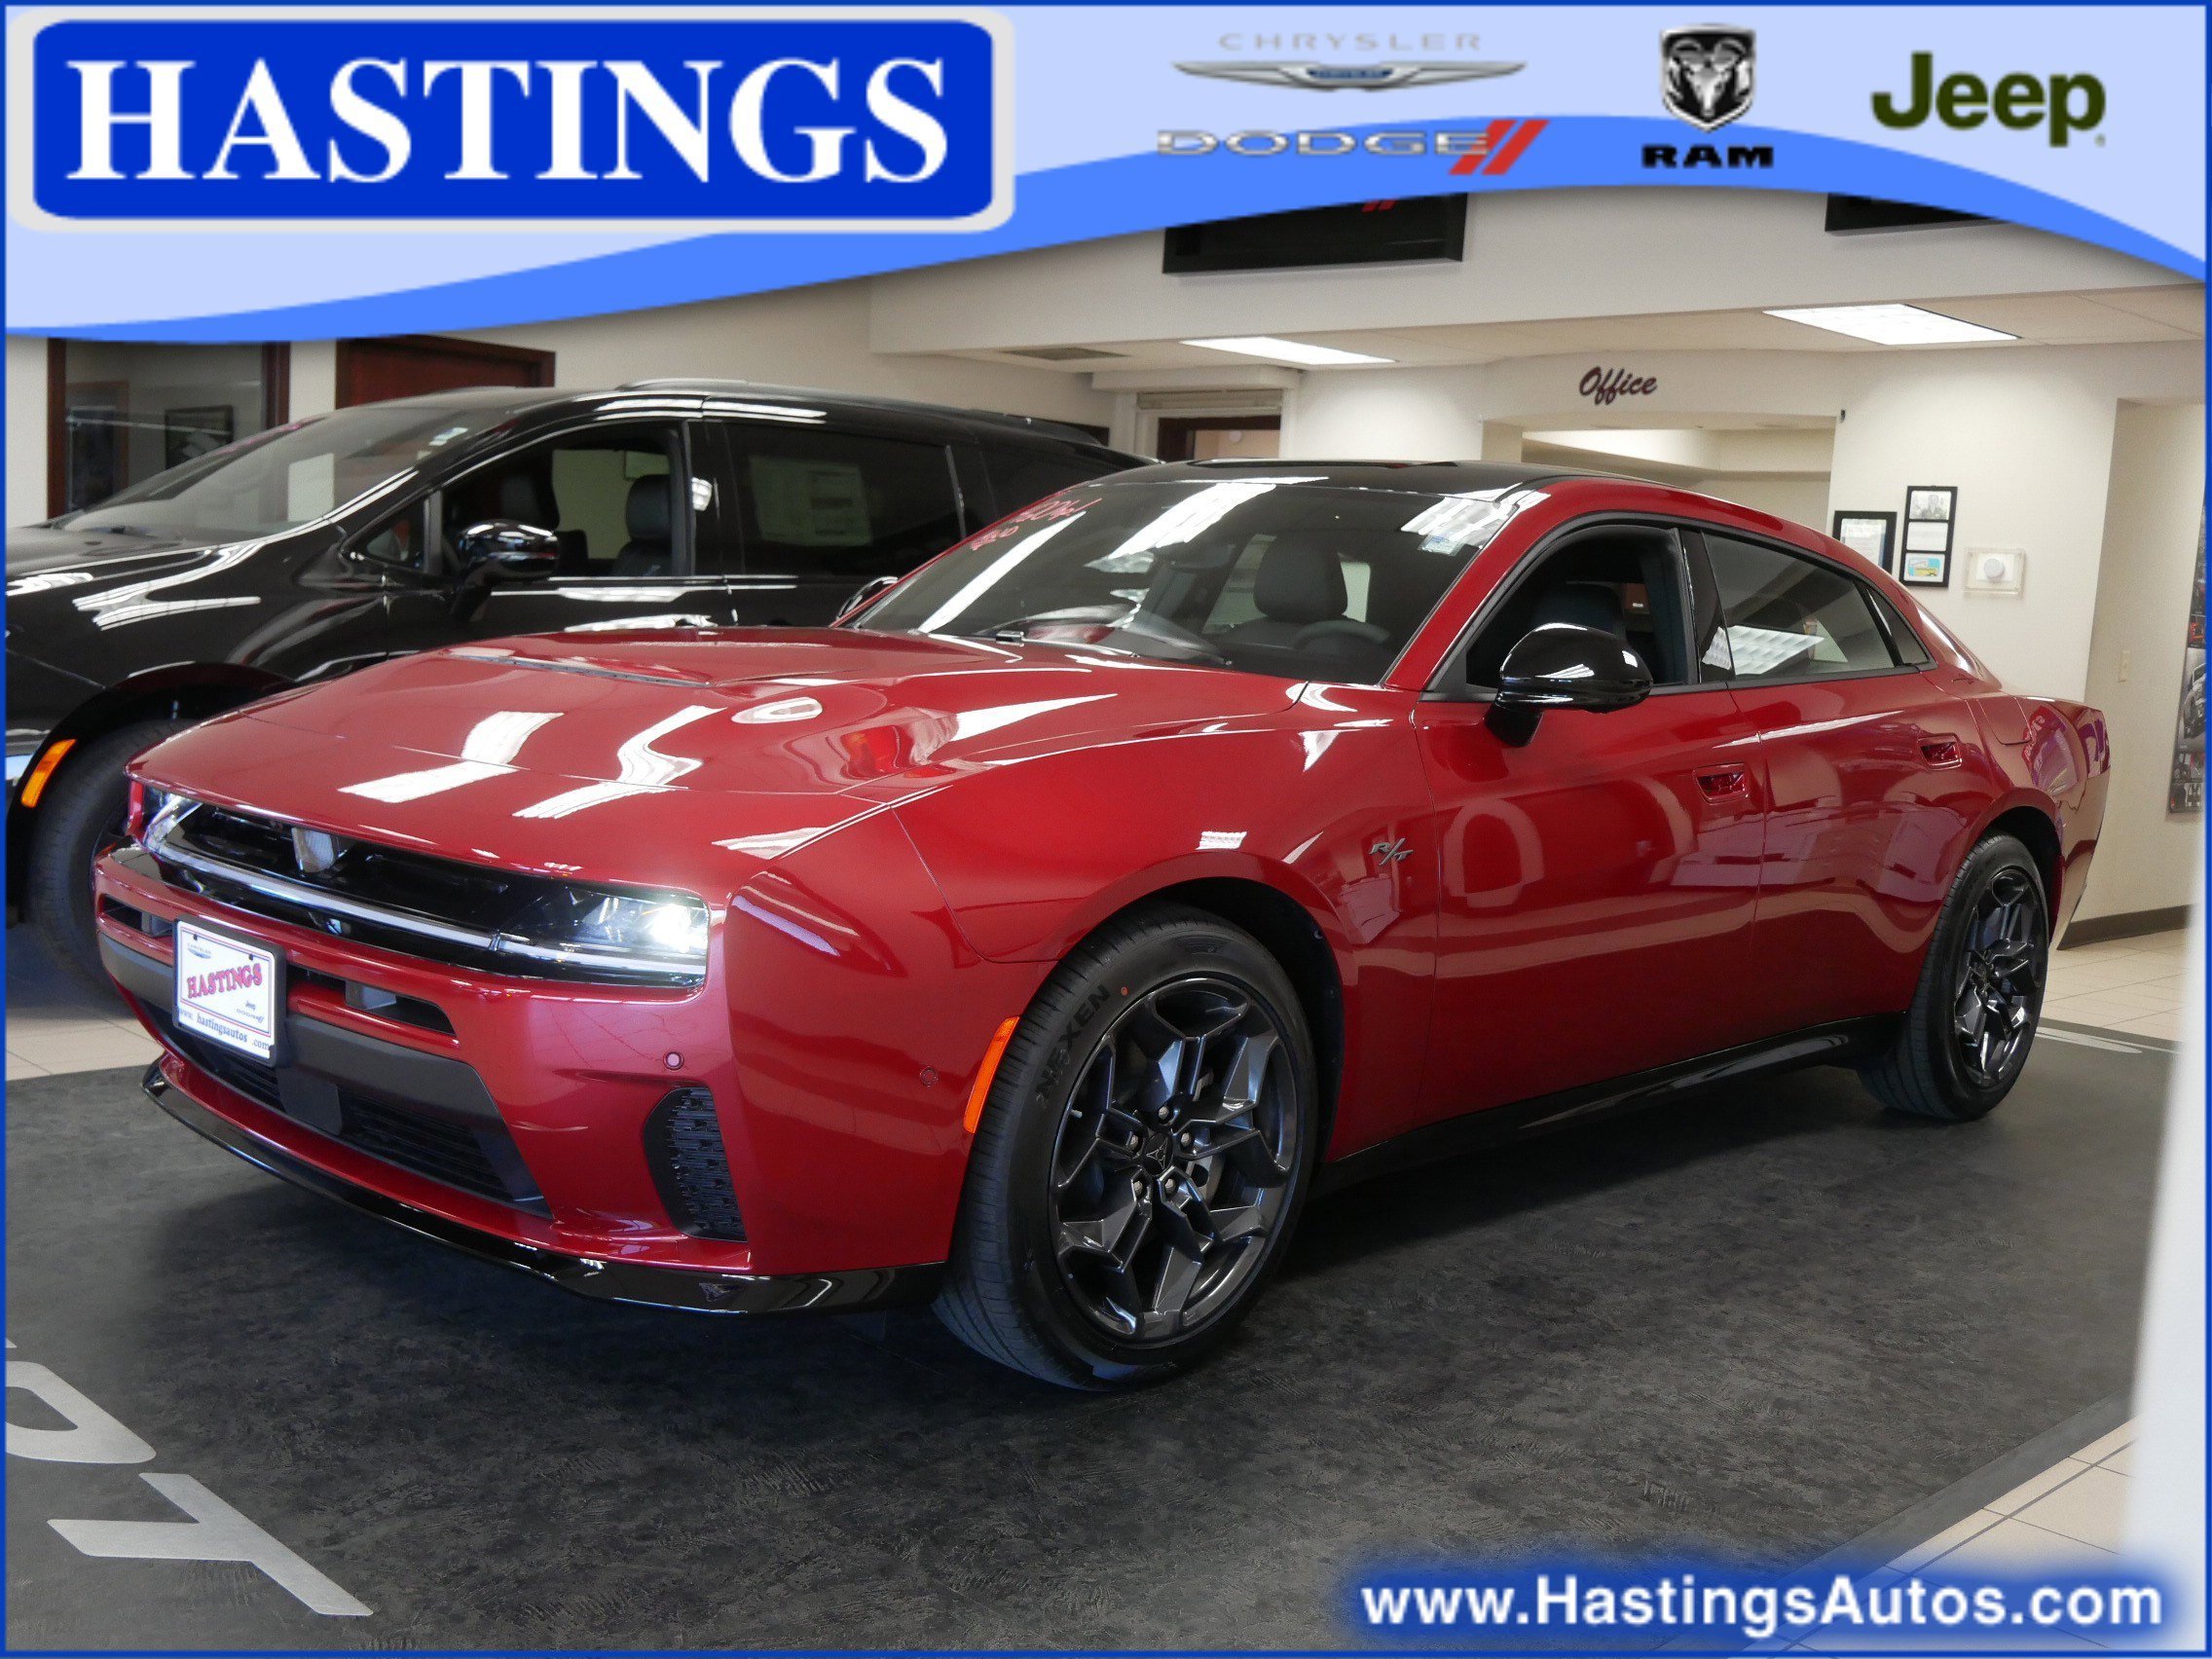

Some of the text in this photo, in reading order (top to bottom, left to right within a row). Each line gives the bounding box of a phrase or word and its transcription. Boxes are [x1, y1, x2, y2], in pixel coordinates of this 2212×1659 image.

[1578, 365, 1658, 406] Office
[1368, 837, 1414, 866] R/T
[187, 963, 263, 999] HASTINGS
[197, 1012, 247, 1043] hastingsautos
[1035, 983, 1111, 1099] NEXEN
